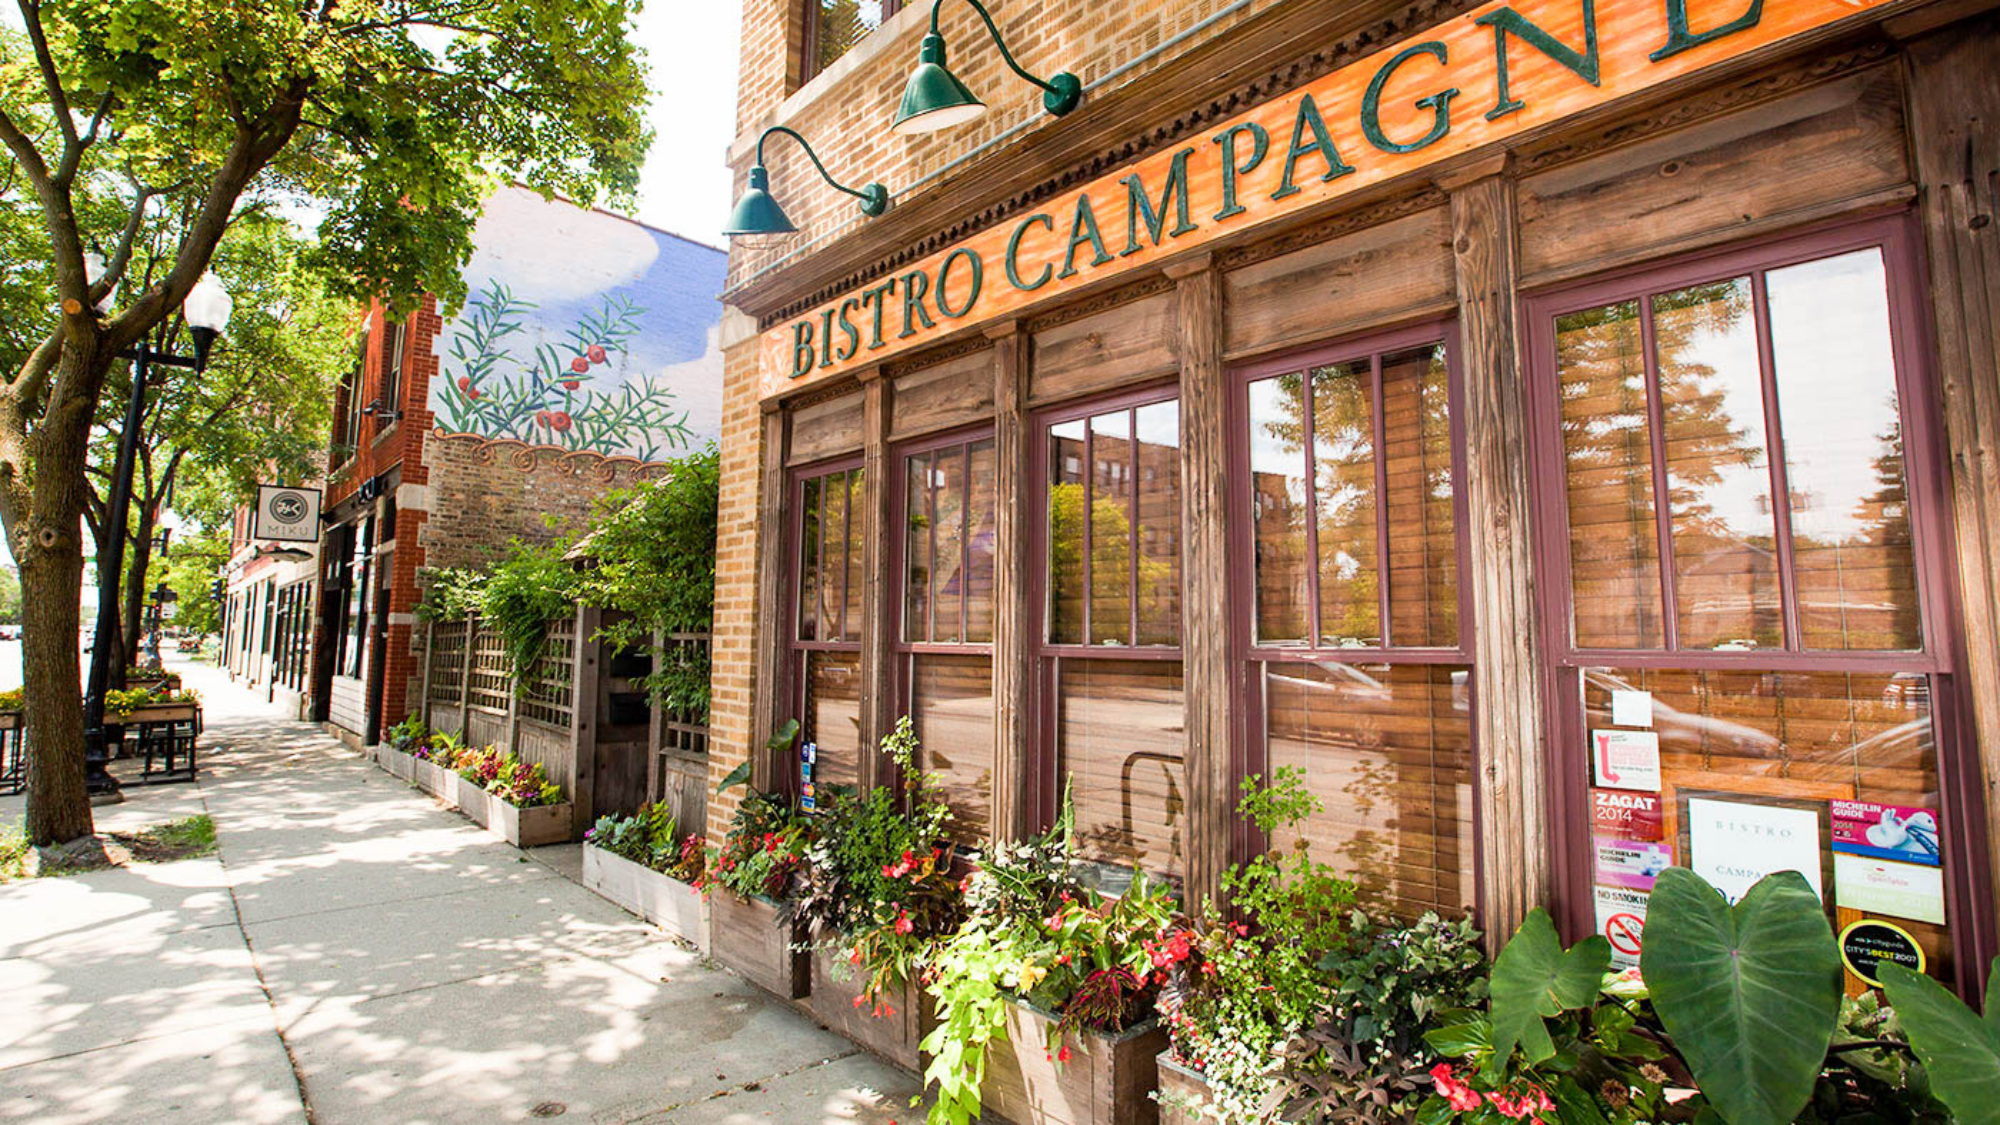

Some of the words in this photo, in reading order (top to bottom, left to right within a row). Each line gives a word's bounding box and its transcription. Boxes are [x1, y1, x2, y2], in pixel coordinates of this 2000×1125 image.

[788, 247, 984, 380] BISTRO
[1596, 792, 1656, 811] ZAGAT
[1832, 800, 1882, 813] MICHELIN
[1596, 806, 1633, 822] 2014
[1832, 807, 1864, 819] GUIDE
[1715, 820, 1792, 838] BISTRO
[1715, 864, 1761, 880] CAMPA
[1597, 890, 1611, 900] NO
